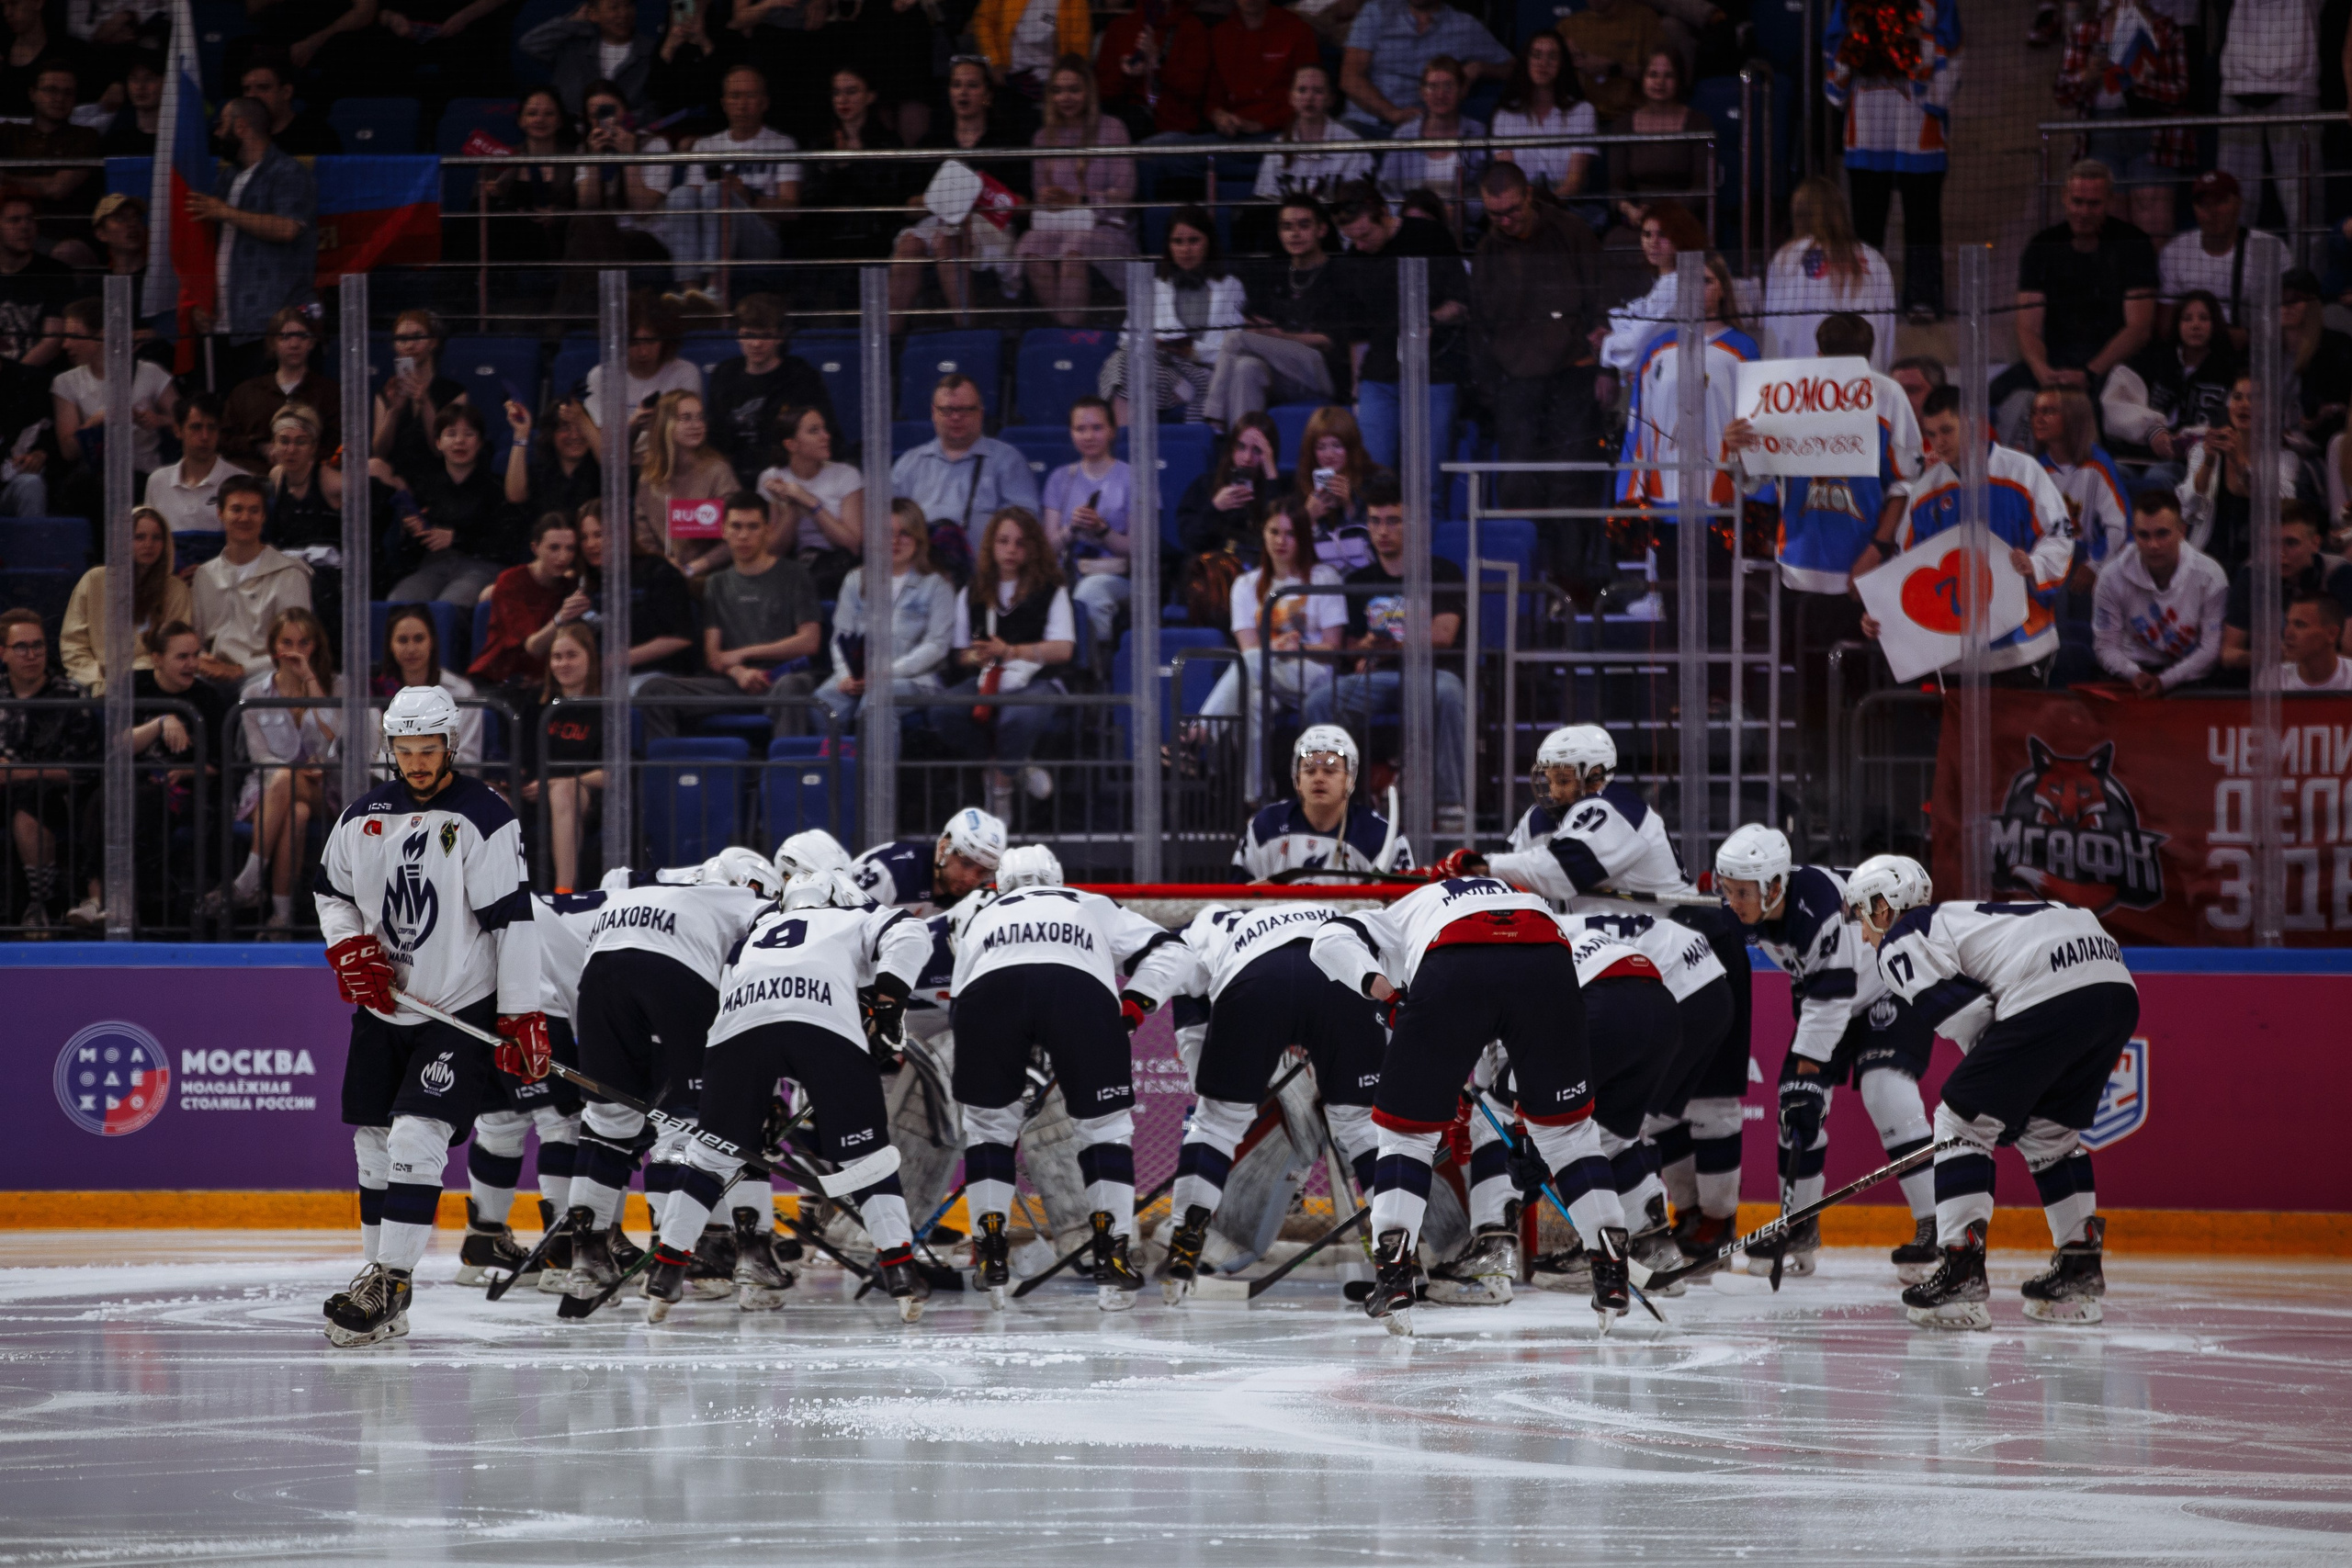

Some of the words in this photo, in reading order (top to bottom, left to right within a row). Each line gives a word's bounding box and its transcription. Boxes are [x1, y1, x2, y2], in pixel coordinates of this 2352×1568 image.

[983, 921, 1094, 953] МАЛАХОВКА
[1886, 951, 1916, 989] 17
[722, 976, 832, 1015] МАЛАХОВКА
[181, 1049, 316, 1076] МОСКВА
[181, 1079, 291, 1095] МОЛОДЁЖНАЯ
[180, 1096, 253, 1111] СТОЛИЦА
[255, 1096, 317, 1111] РОССИИ
